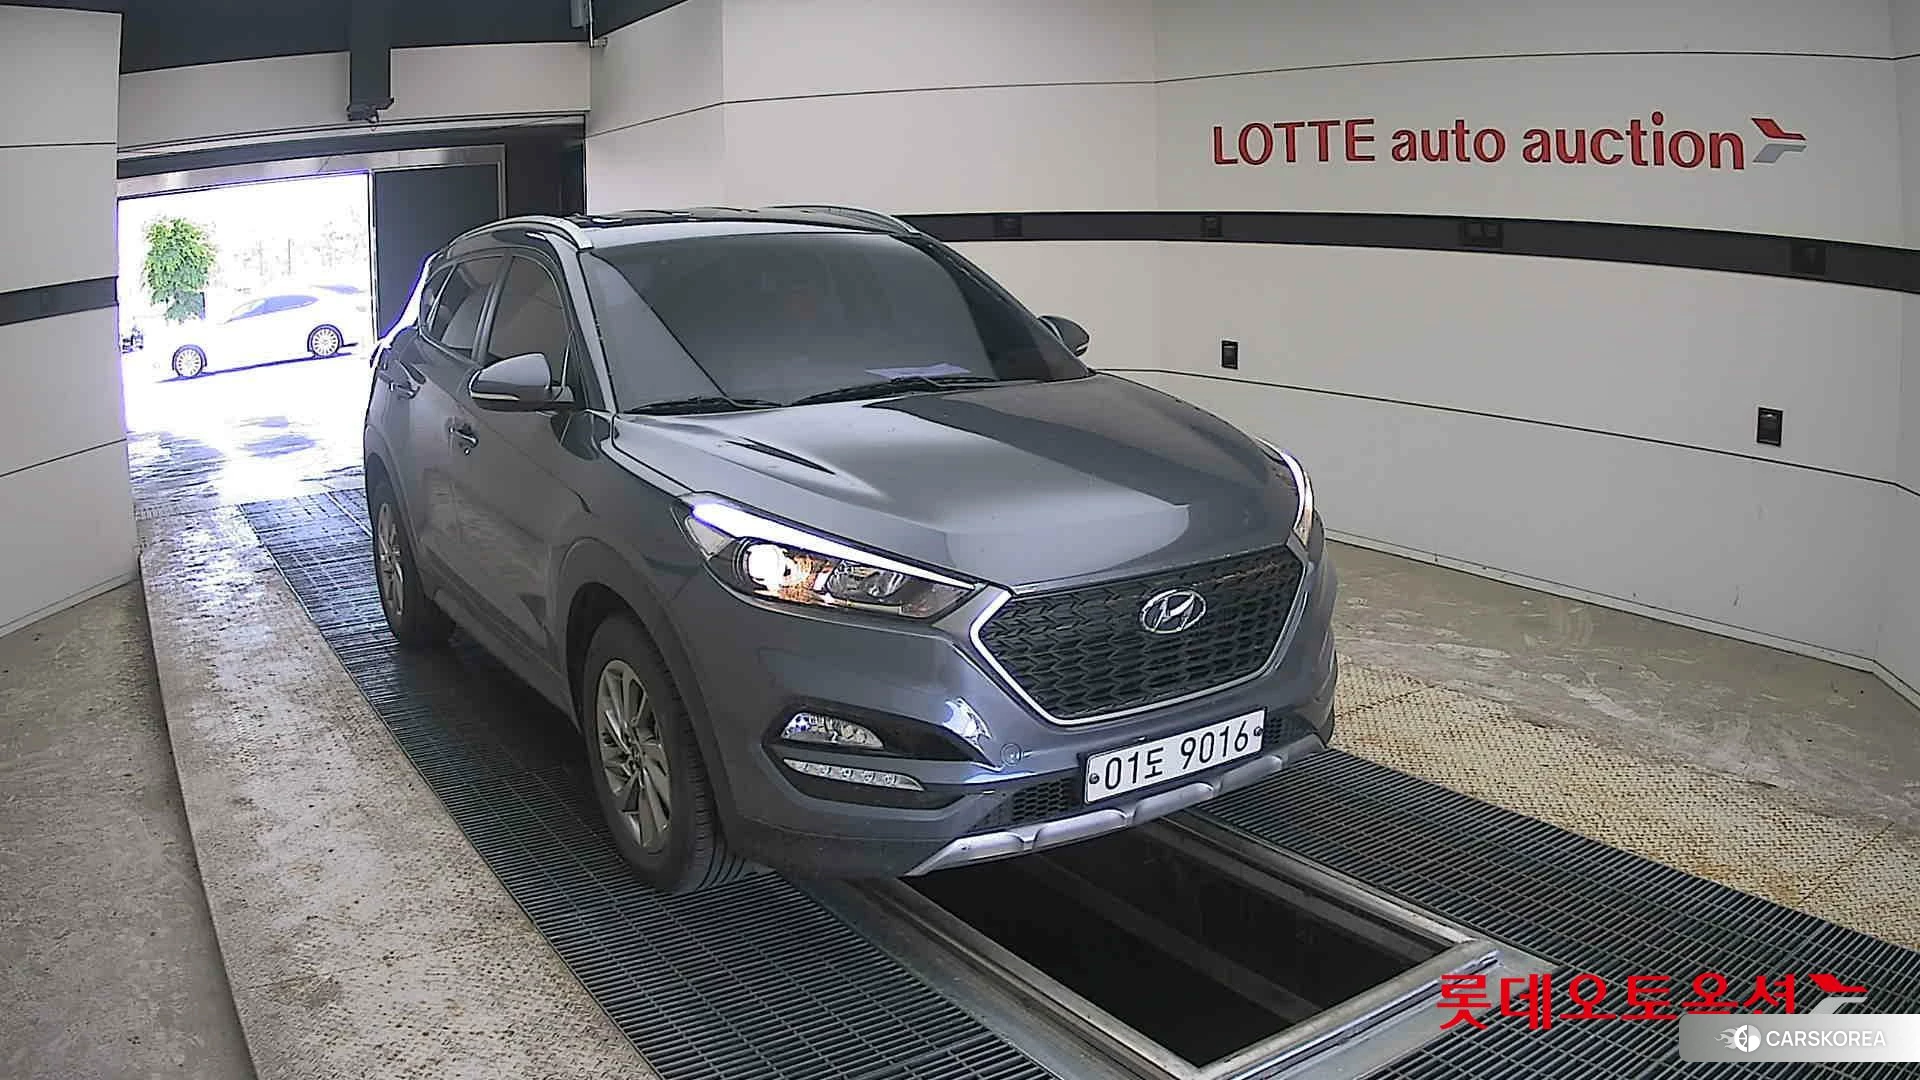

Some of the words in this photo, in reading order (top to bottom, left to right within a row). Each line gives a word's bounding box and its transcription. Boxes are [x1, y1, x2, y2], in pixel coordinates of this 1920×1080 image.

[1213, 119, 1376, 165] LOTTE
[1391, 119, 1506, 163] auto
[1522, 111, 1745, 170] auction
[1104, 746, 1165, 790] 01도
[1180, 720, 1249, 769] 9016
